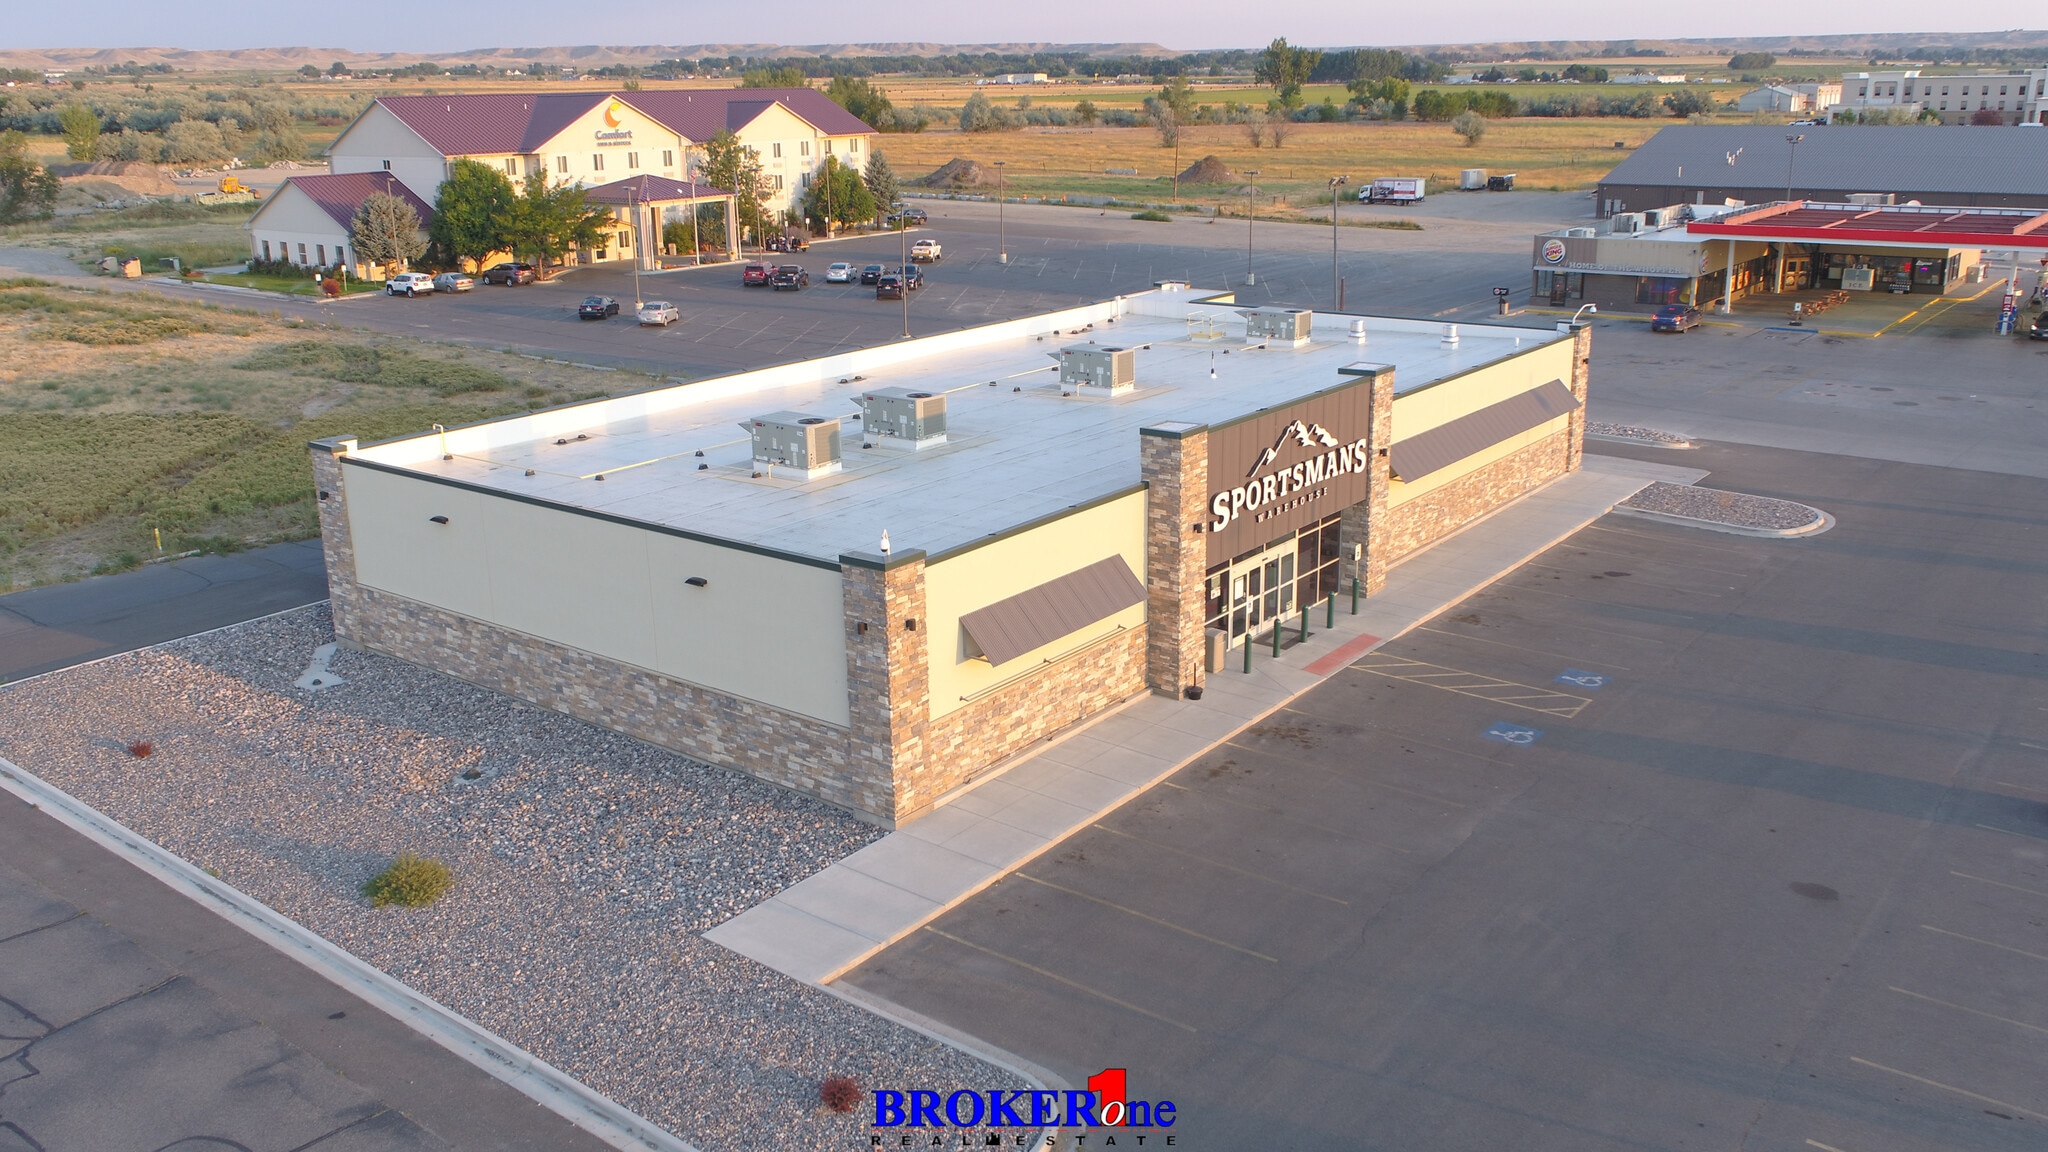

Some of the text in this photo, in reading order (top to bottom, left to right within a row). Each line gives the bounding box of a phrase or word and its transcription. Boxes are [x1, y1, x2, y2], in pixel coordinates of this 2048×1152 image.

[595, 129, 632, 140] Comfort
[1546, 248, 1562, 256] KING
[1211, 438, 1367, 533] SPORTSMANS
[1256, 487, 1328, 524] WAREHOUSE
